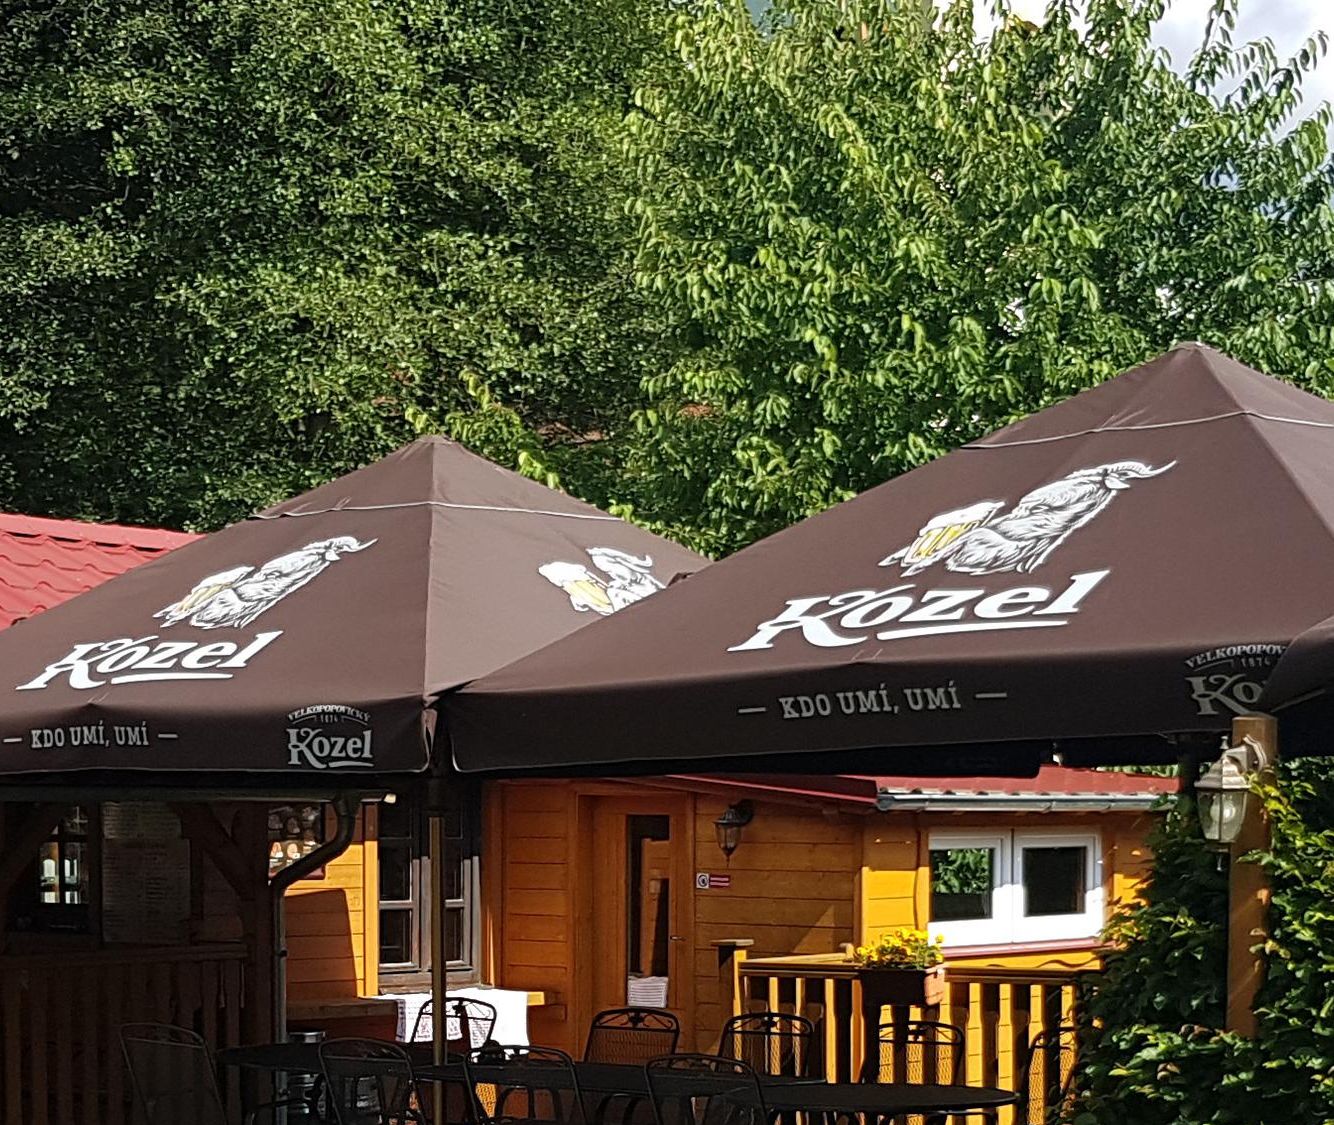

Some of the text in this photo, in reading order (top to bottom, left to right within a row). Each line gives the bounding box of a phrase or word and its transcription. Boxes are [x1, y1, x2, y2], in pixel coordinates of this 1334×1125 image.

[726, 569, 1111, 651] Kozel
[15, 630, 283, 690] Kozel
[1184, 644, 1288, 668] VELKOPOPOV
[779, 680, 962, 719] KDO UMÍ, UMÍ
[31, 720, 150, 749] KDO UMÍ, UMÍ
[285, 727, 374, 769] Kozel
